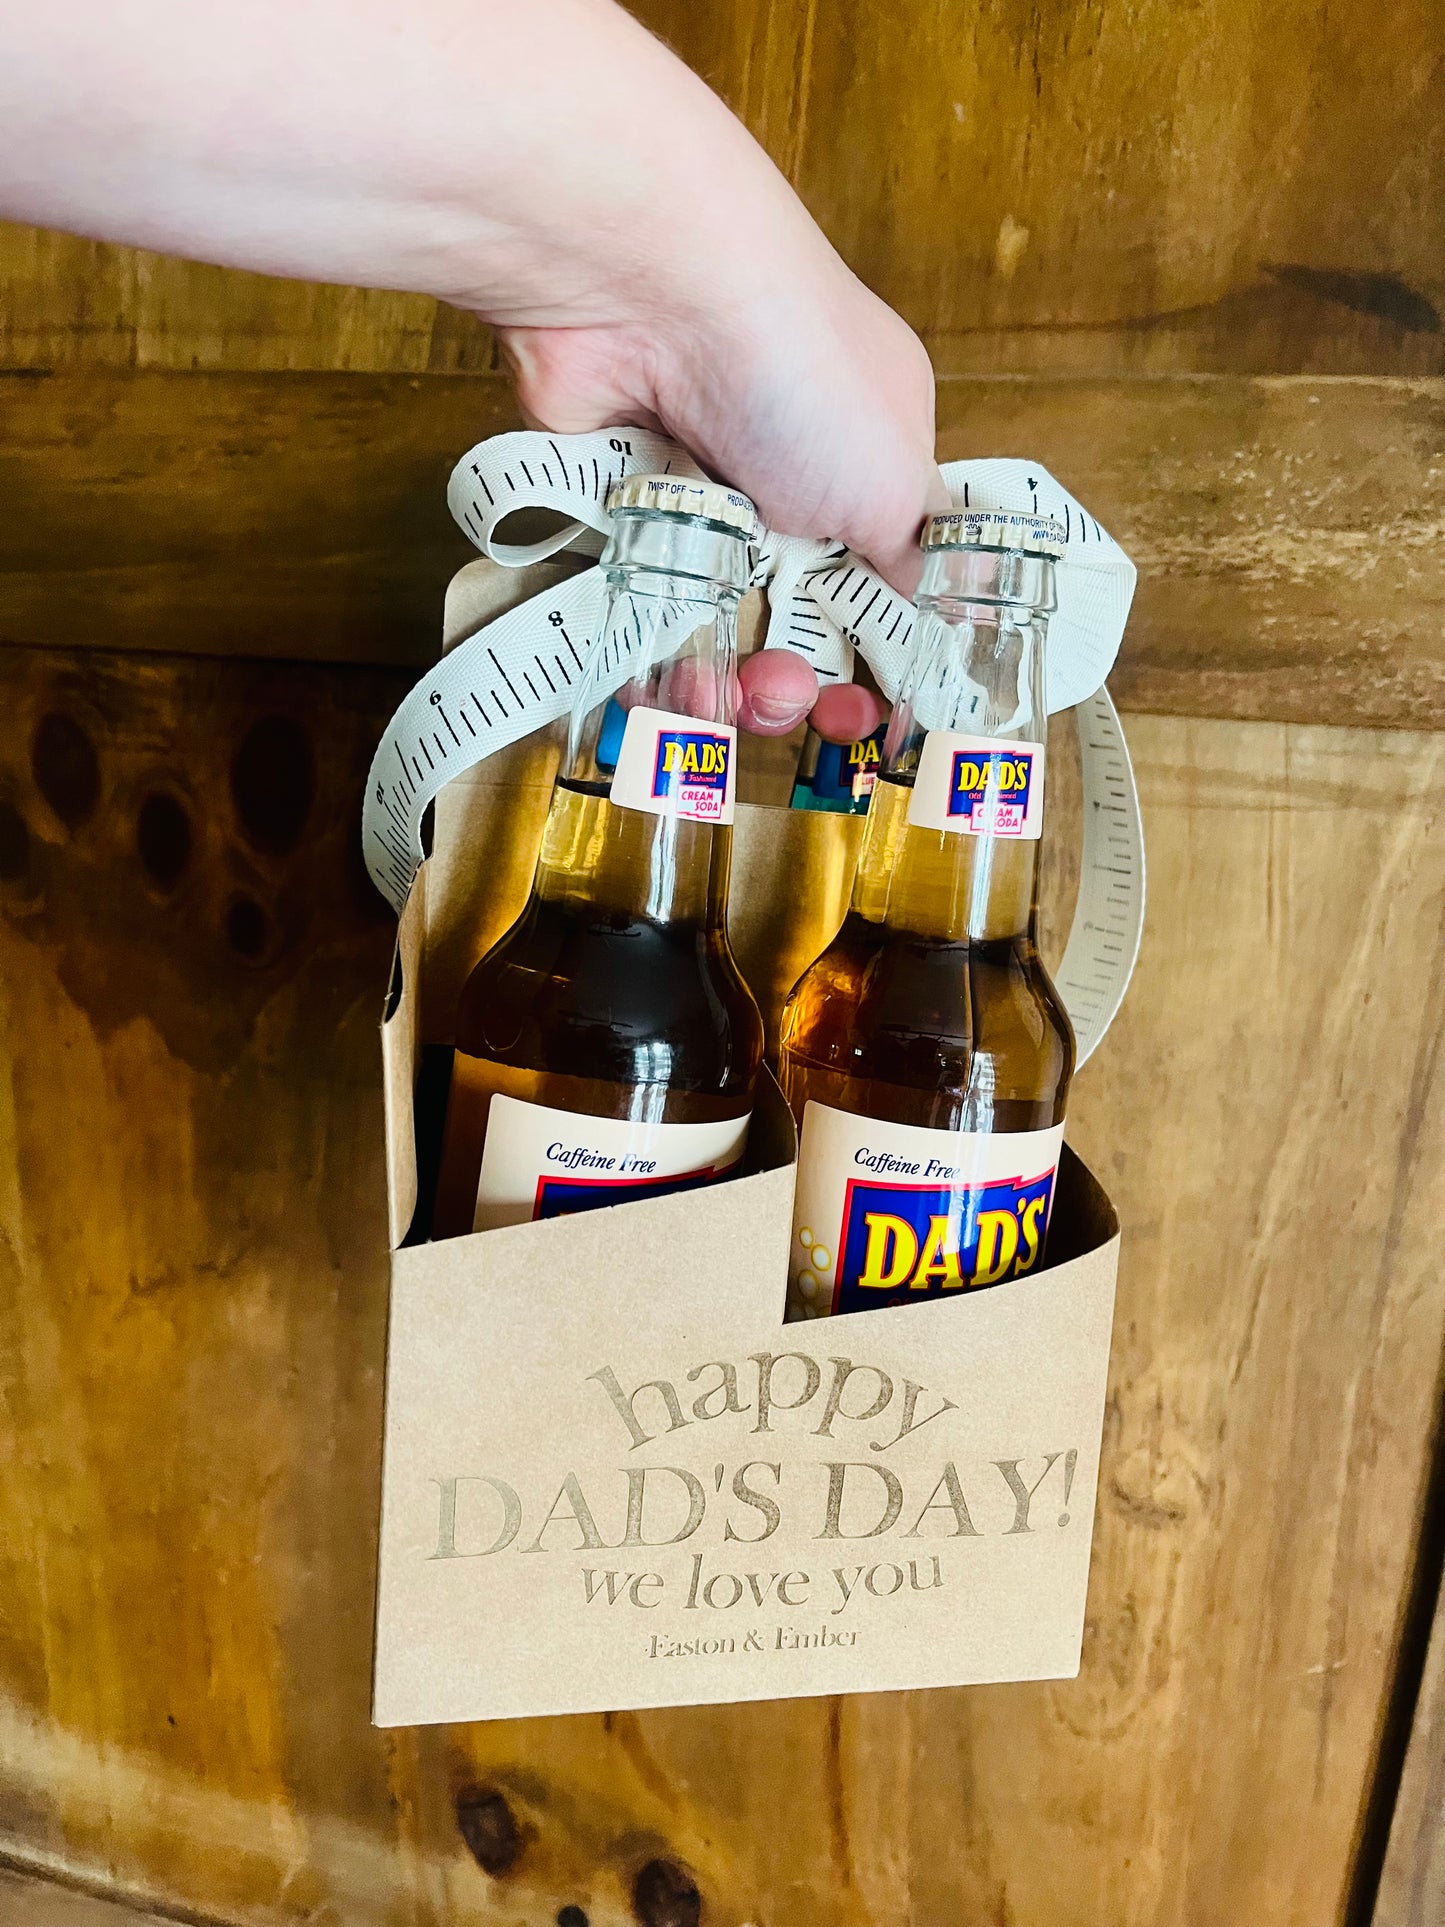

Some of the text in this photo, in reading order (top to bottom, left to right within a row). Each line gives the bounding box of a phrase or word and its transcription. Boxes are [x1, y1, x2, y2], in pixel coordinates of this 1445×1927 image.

[648, 480, 687, 494] TWIST OFF
[965, 514, 991, 523] UNDER
[993, 514, 1009, 524] THE
[1010, 516, 1048, 529] AUTHORITY
[547, 610, 564, 627] 8
[662, 741, 727, 774] DAD'S
[681, 791, 714, 801] CREAM
[694, 801, 719, 811] SODA
[977, 807, 1012, 818] CAM
[546, 1142, 657, 1173] Caffeine Free
[854, 1147, 961, 1179] Caffeine Free
[857, 1193, 1047, 1290] DAD'S
[585, 1351, 960, 1451] happy
[425, 1448, 1078, 1561] DAD'S DAY!
[580, 1553, 945, 1616] we love you
[742, 1629, 765, 1653] &
[773, 1625, 862, 1651] Ember
